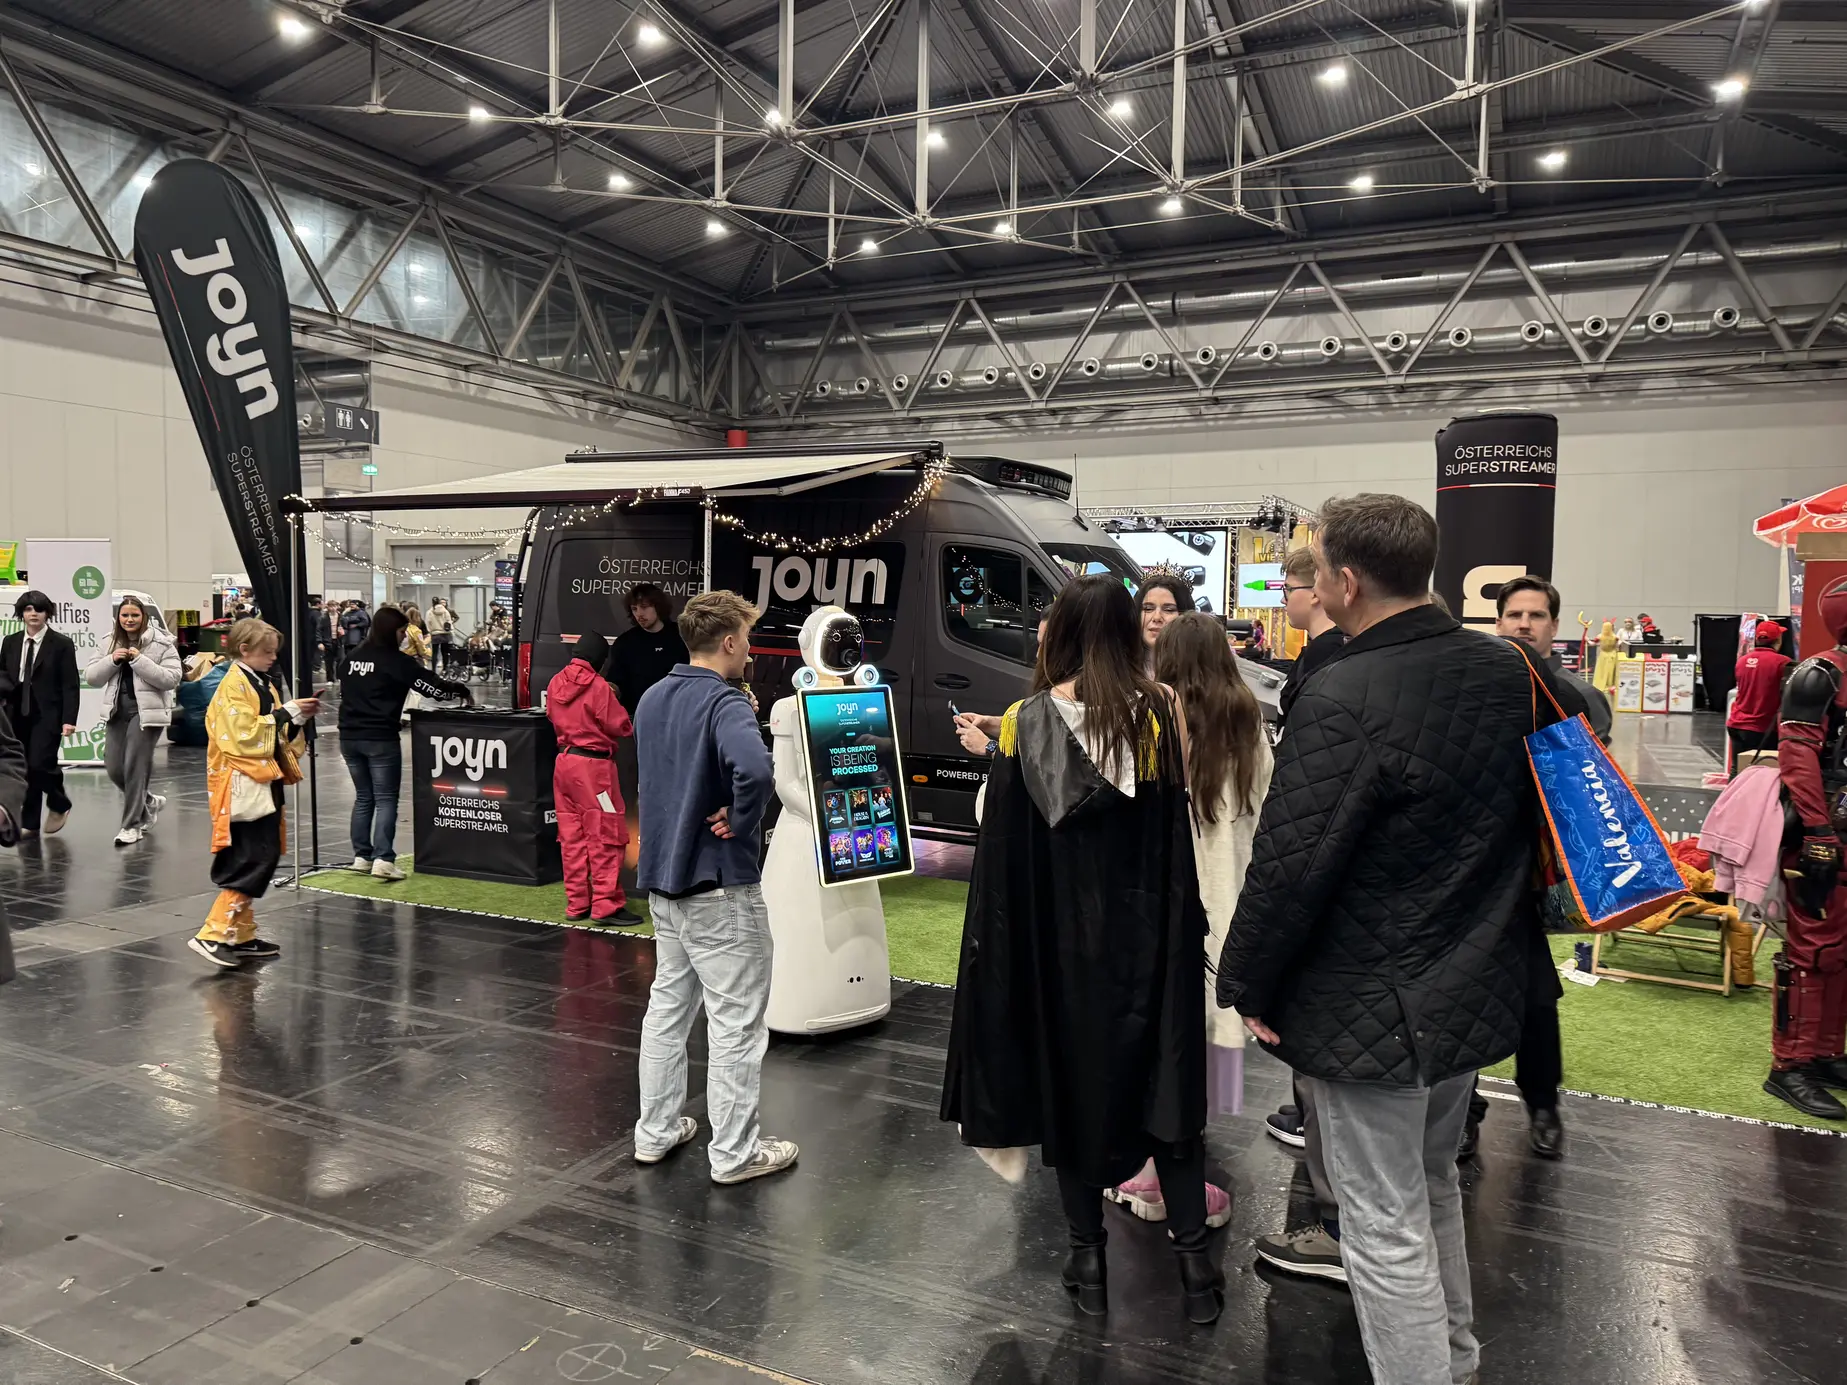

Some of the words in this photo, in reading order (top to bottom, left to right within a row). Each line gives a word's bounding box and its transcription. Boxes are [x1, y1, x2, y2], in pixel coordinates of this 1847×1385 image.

[1455, 444, 1552, 460] ÖSTERREICHS
[1445, 461, 1556, 476] SUPERSTREAMER
[227, 453, 277, 576] SUPERSTREAMER
[847, 745, 876, 753] CREATION
[830, 755, 840, 767] IS
[843, 752, 877, 766] BEING
[832, 764, 878, 776] PROCESSED
[937, 769, 979, 781] POWERED
[982, 773, 990, 782] B
[439, 794, 499, 809] ÖSTERREICHS
[438, 807, 502, 822] KOSTENLOSER
[434, 817, 508, 833] SUPERSTREAMER
[1581, 760, 1641, 888] Valencia
